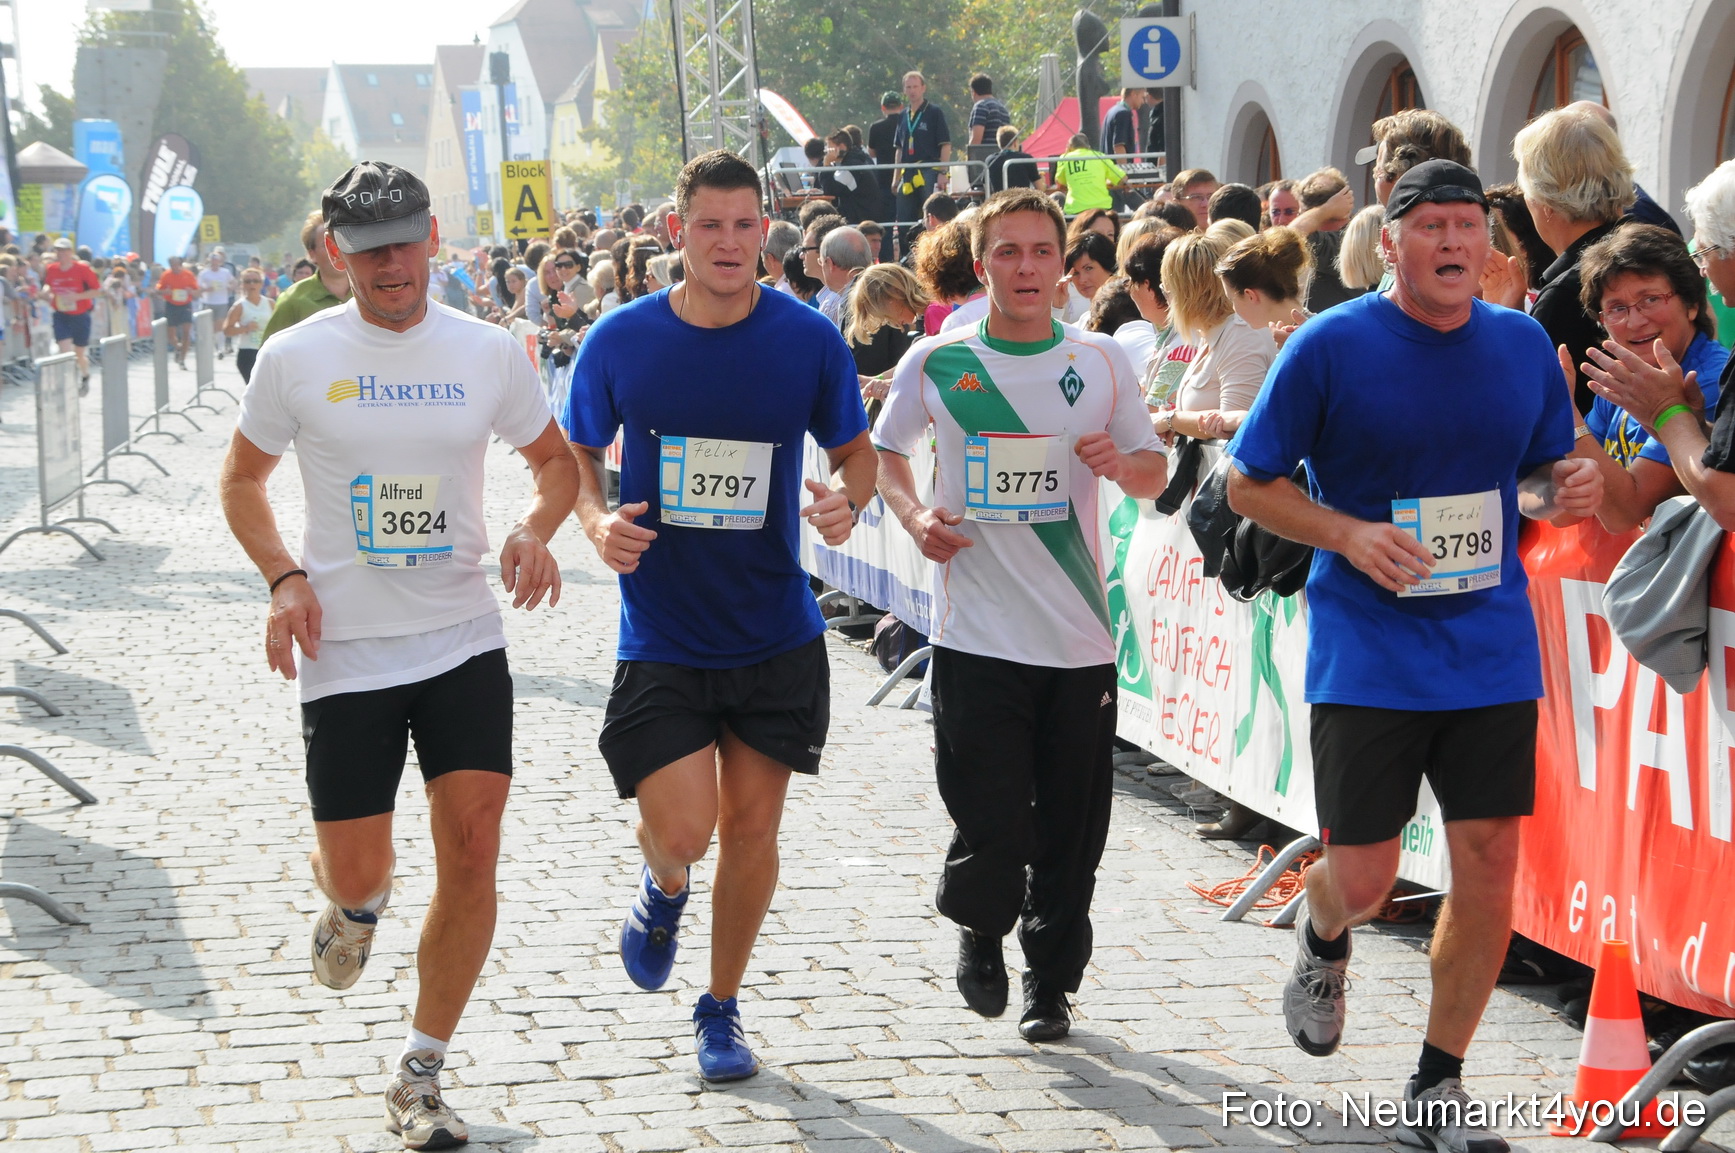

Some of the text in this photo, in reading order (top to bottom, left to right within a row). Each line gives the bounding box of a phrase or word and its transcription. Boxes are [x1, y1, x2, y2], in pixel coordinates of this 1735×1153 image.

[506, 165, 546, 178] Block
[343, 188, 402, 210] POLO
[514, 184, 543, 221] A
[356, 375, 465, 401] HÄRTEIS
[693, 440, 738, 458] Felix
[380, 483, 422, 500] Alfred
[691, 473, 756, 498] 3797
[996, 470, 1058, 493] 3775
[357, 509, 363, 521] B
[382, 510, 447, 535] 3624
[724, 515, 764, 524] PFLEIDERER
[1030, 508, 1067, 517] PFLEIDERER
[1436, 505, 1481, 522] Fredi
[1432, 529, 1492, 560] 3798
[418, 552, 453, 562] PFLEIDERER
[1468, 570, 1500, 584] PFLEIDERER
[1156, 686, 1222, 765] ESSER
[1568, 880, 1640, 965] eat
